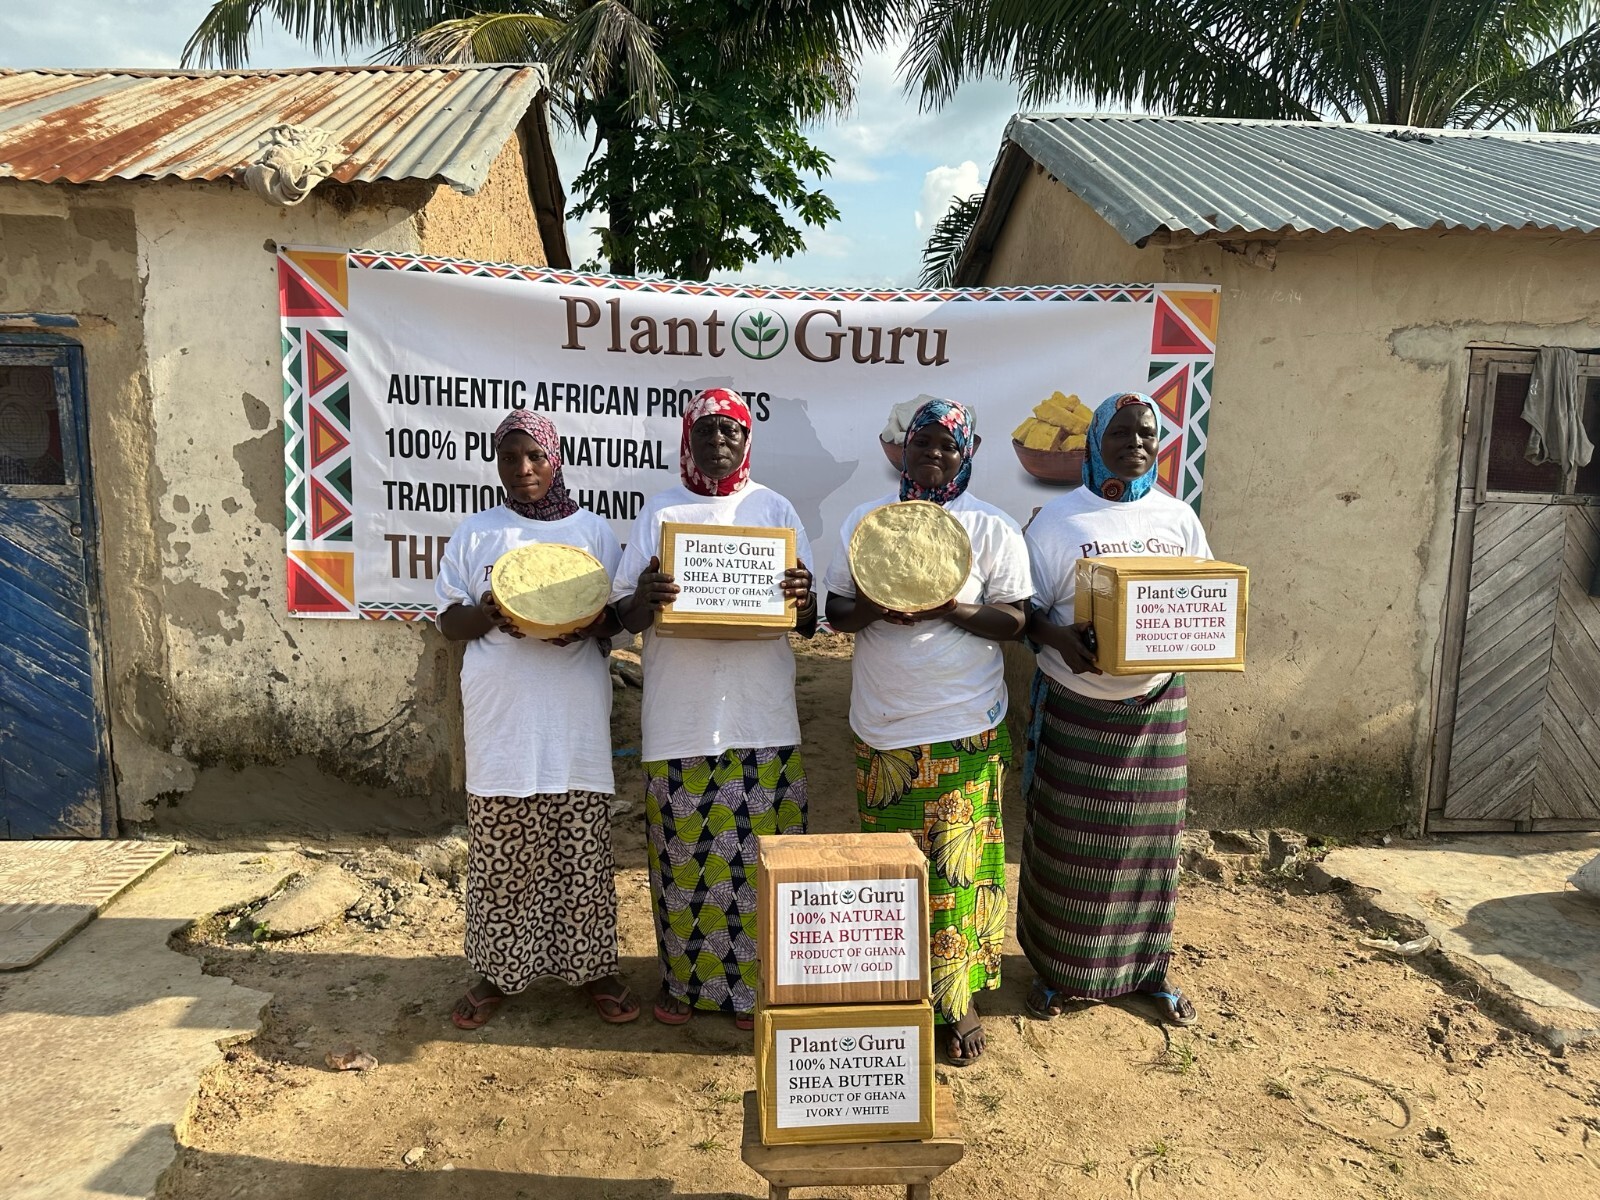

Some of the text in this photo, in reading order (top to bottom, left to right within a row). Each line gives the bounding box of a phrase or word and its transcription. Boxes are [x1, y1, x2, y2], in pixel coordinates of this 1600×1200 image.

[559, 295, 949, 366] Plant Guru
[387, 374, 770, 422] AUTHENTIC AFRICAN PROTS
[385, 428, 456, 461] 100%
[560, 436, 668, 469] NATURAL
[579, 489, 645, 520] HAND
[685, 540, 775, 556] Plant Guru
[1080, 540, 1129, 558] Plant
[684, 557, 775, 570] 100% NATURAL
[683, 571, 774, 585] SHEA BUTTER
[683, 586, 775, 597] PRODUCT OF GHANA
[1137, 585, 1227, 599] Plant Guru
[696, 598, 725, 607] IVORY
[732, 599, 762, 608] WHITE
[1136, 602, 1227, 614] 100% NATURAL
[1135, 616, 1226, 629] SHEA BUTTER
[1136, 631, 1226, 641] PRODUCT OF GHANA
[1146, 645, 1184, 653] YELLOW
[1191, 644, 1216, 652] GOLD
[790, 887, 905, 906] Plant Guru
[790, 909, 906, 925] 100% NATURAL
[790, 927, 906, 945] SHEA BUTTER
[790, 946, 906, 960] PRODUCT OF GHANA
[803, 963, 852, 975] YELLOW
[861, 962, 893, 972] GOLD
[789, 1034, 906, 1053] Plant Guru
[789, 1055, 906, 1071] 100% NATURAL
[789, 1073, 906, 1090] SHEA BUTTER
[790, 1091, 906, 1104] PRODUCT OF GHANA
[806, 1107, 843, 1118] IVORY
[852, 1105, 889, 1115] WHITE
